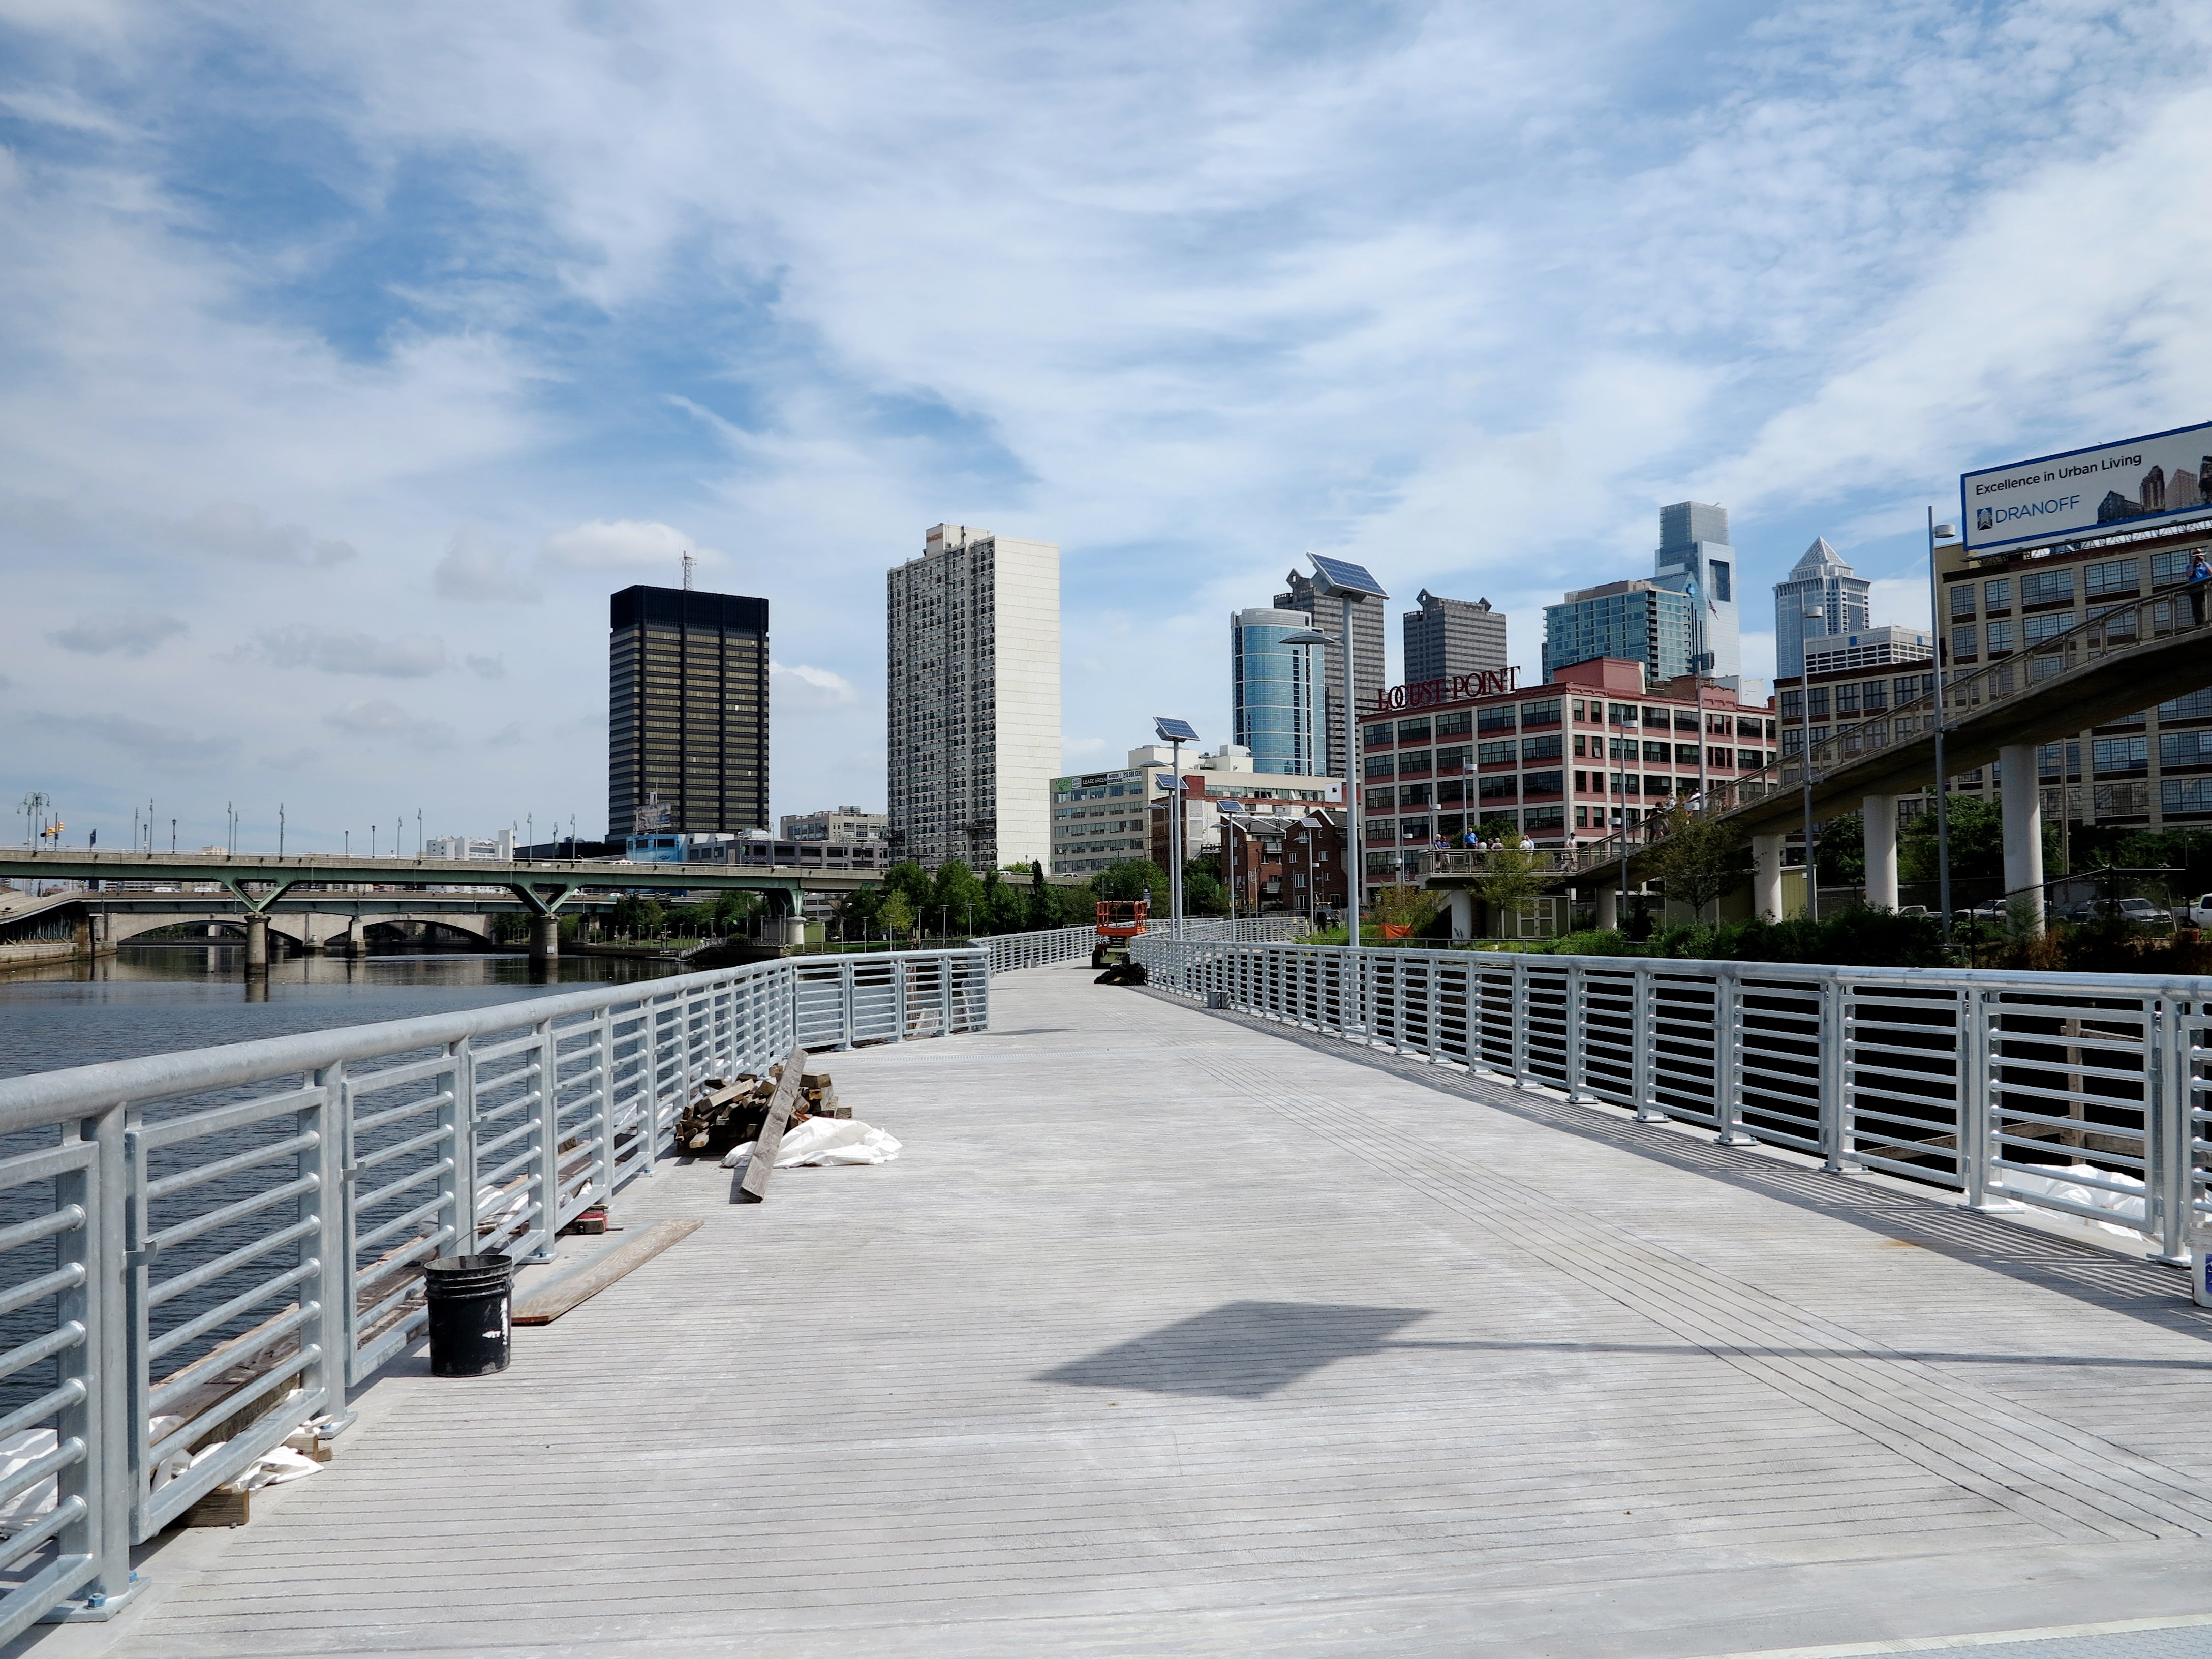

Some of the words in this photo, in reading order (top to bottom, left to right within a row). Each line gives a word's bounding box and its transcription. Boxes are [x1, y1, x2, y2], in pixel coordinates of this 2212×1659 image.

[1976, 475, 2040, 495] Excellence
[2044, 472, 2054, 481] in
[2059, 464, 2098, 479] Urban
[2102, 454, 2142, 471] Living
[1995, 495, 2080, 523] DRANOFF
[1377, 679, 1446, 711] LOCUST
[1452, 666, 1521, 700] POINT
